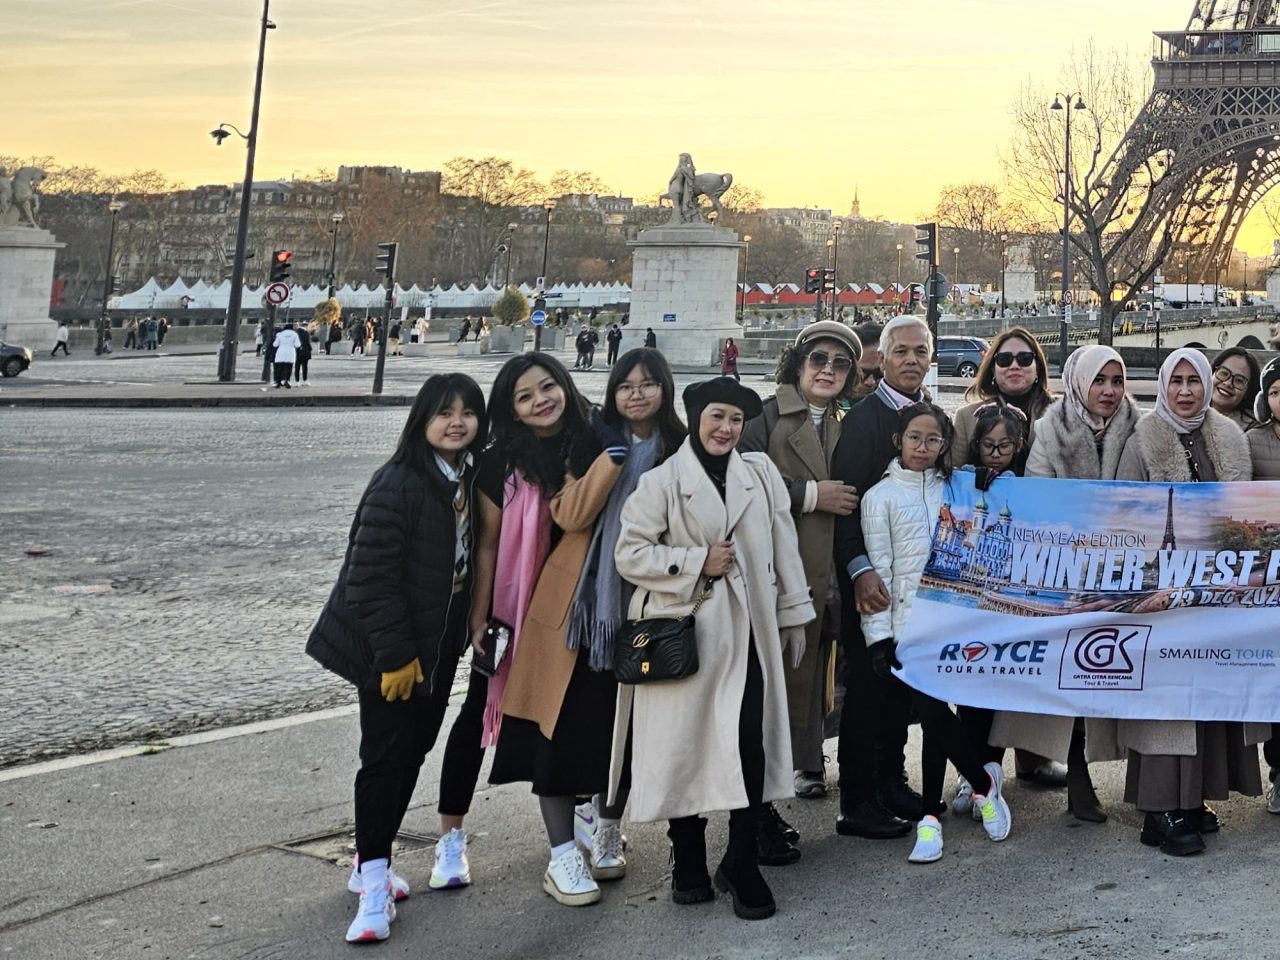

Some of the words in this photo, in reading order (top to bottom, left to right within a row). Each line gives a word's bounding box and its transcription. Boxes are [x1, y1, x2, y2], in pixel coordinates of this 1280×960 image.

[1012, 527, 1045, 543] NEW
[1049, 530, 1087, 546] YEAR
[1090, 532, 1146, 548] EDITION
[1010, 543, 1146, 590] WINTER
[1158, 549, 1260, 589] WEST
[1169, 591, 1195, 609] 23
[1200, 589, 1236, 605] DEC
[940, 640, 1049, 663] ROYCE
[1159, 648, 1231, 660] SMAILING
[1235, 649, 1274, 660] TOUR
[937, 665, 972, 675] TOUR
[978, 665, 985, 674] &
[992, 666, 1042, 676] TRAVEL
